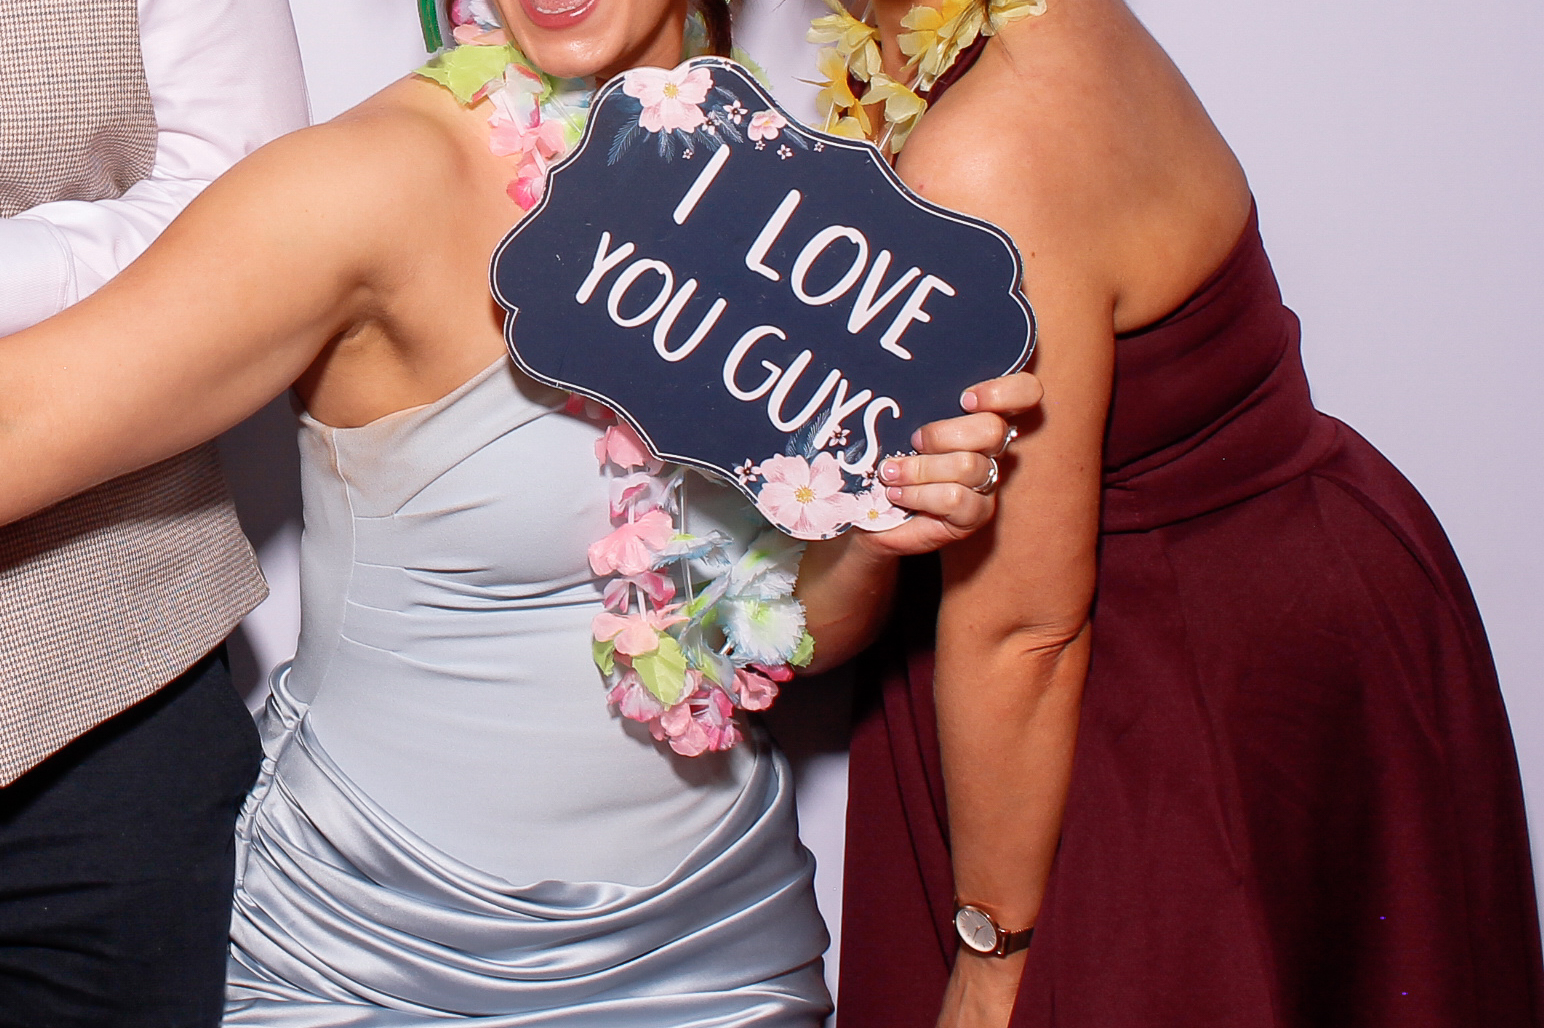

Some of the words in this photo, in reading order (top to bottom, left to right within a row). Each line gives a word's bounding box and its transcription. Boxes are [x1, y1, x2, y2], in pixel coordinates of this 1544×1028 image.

[575, 231, 727, 362] YOU
[722, 325, 900, 475] GUYS
[673, 144, 730, 225] I
[745, 189, 956, 360] LOVE
